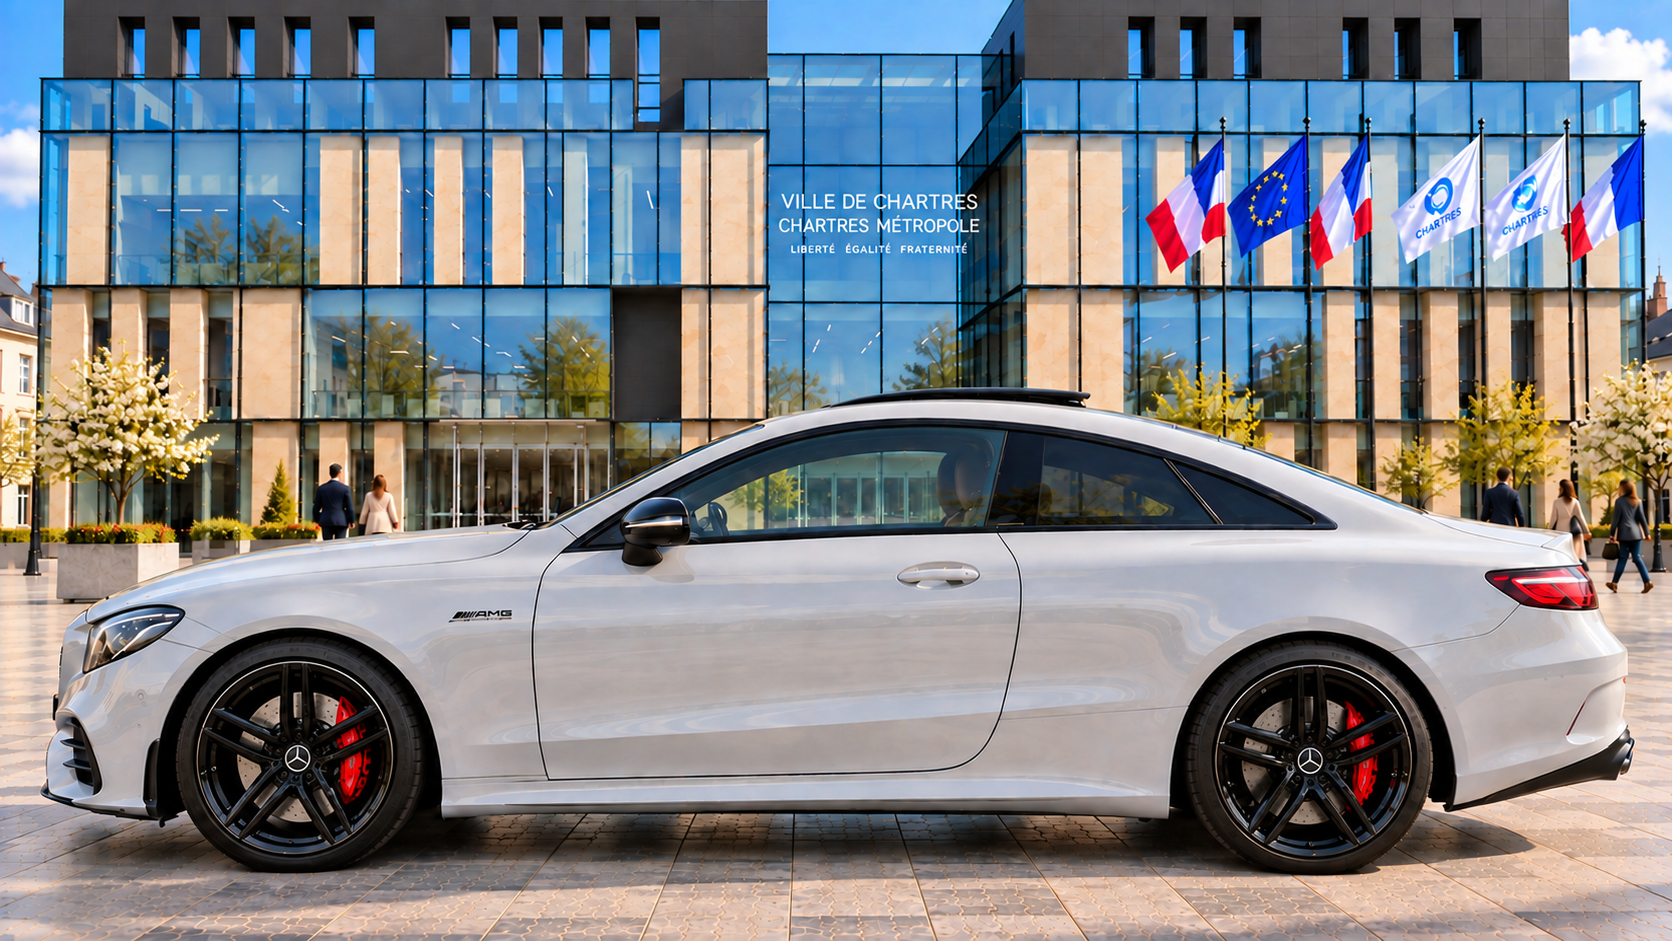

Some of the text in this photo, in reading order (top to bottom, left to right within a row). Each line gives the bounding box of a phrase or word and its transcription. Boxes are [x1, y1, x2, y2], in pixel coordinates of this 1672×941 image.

[781, 193, 978, 210] VILLE DE CHARTRES
[778, 214, 980, 233] CHARTRES MÉTROPOLE
[1415, 207, 1462, 239] CHARTRES
[790, 242, 968, 254] LIBERTÉ ÉGALITÉ FRATERNITÉ
[475, 609, 513, 618] AMG
